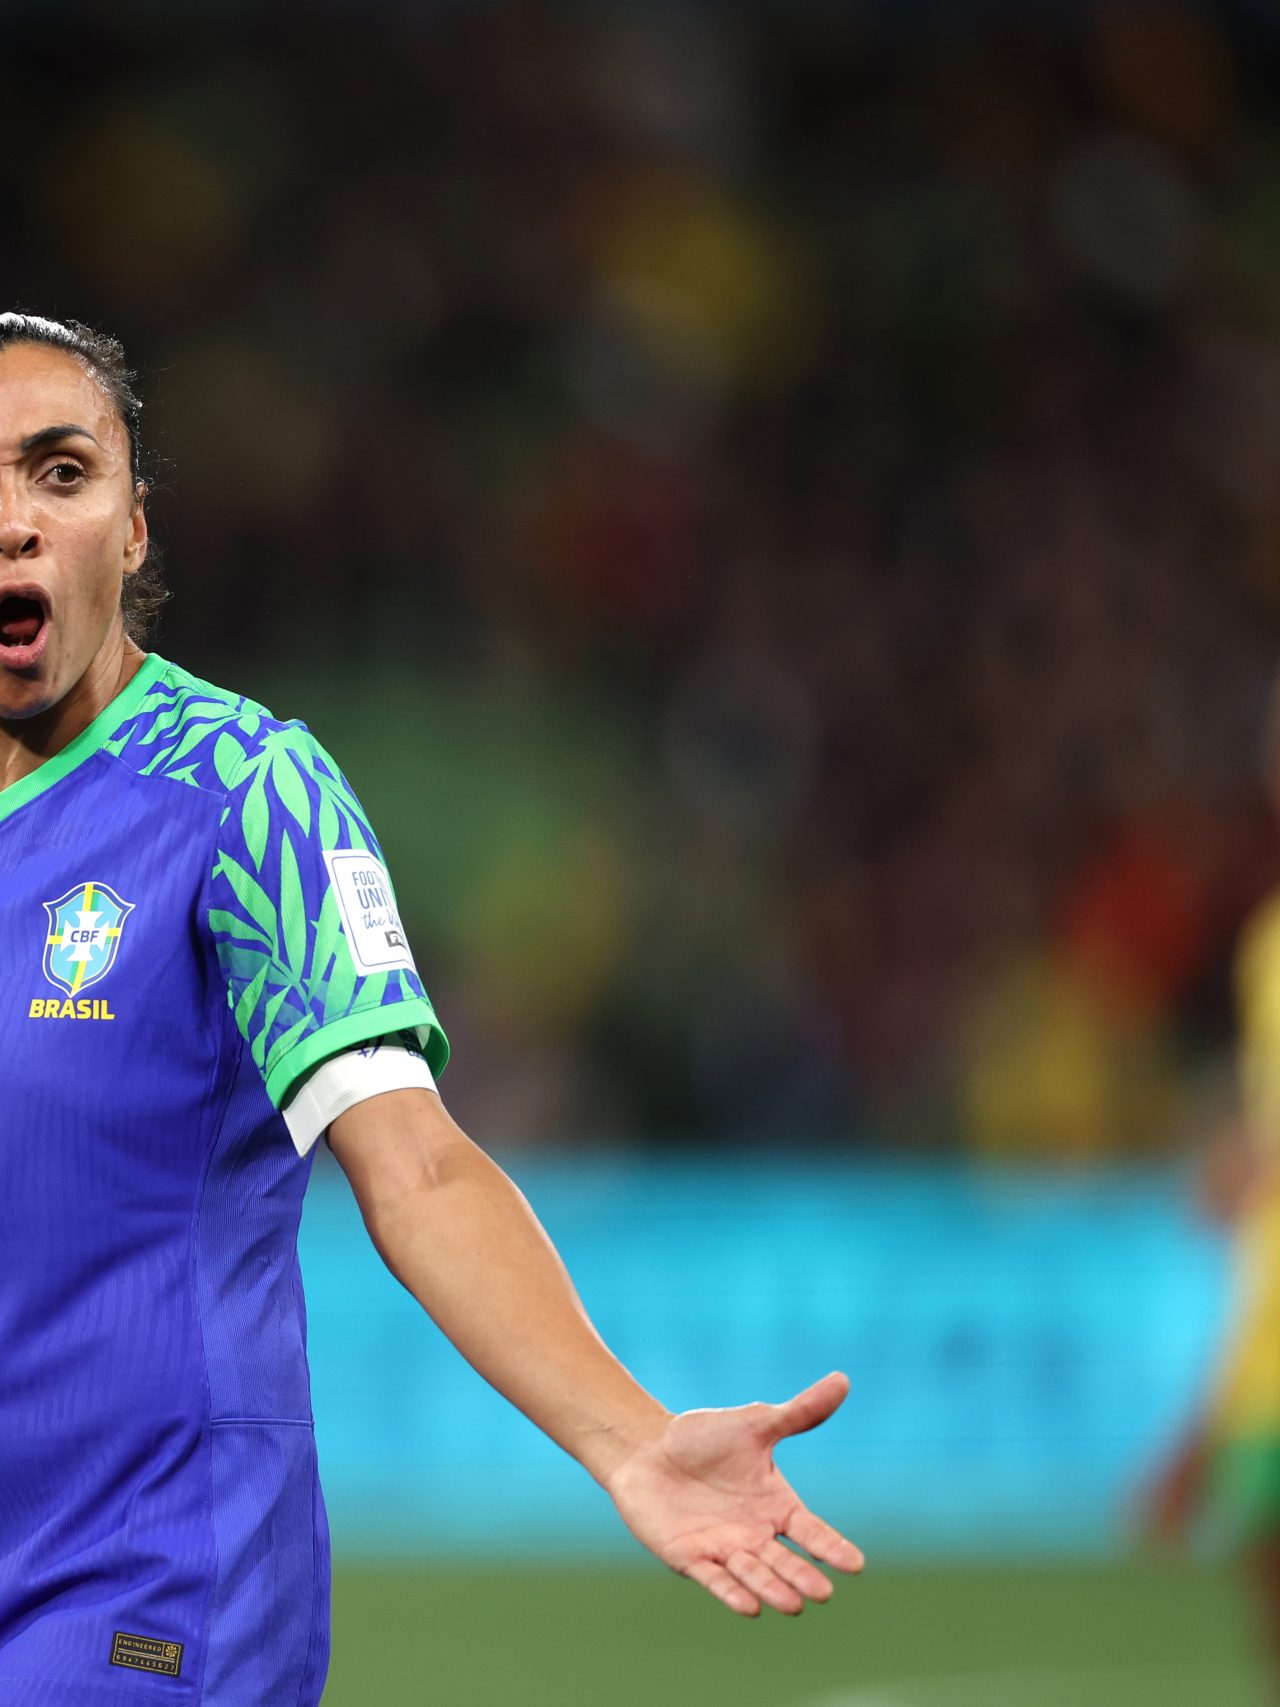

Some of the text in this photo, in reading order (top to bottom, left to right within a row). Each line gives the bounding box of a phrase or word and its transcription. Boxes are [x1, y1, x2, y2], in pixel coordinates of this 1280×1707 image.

[361, 911, 386, 929] the
[70, 930, 100, 943] CBF
[28, 998, 115, 1020] BRASIL
[118, 1638, 162, 1652] ENGINEERED
